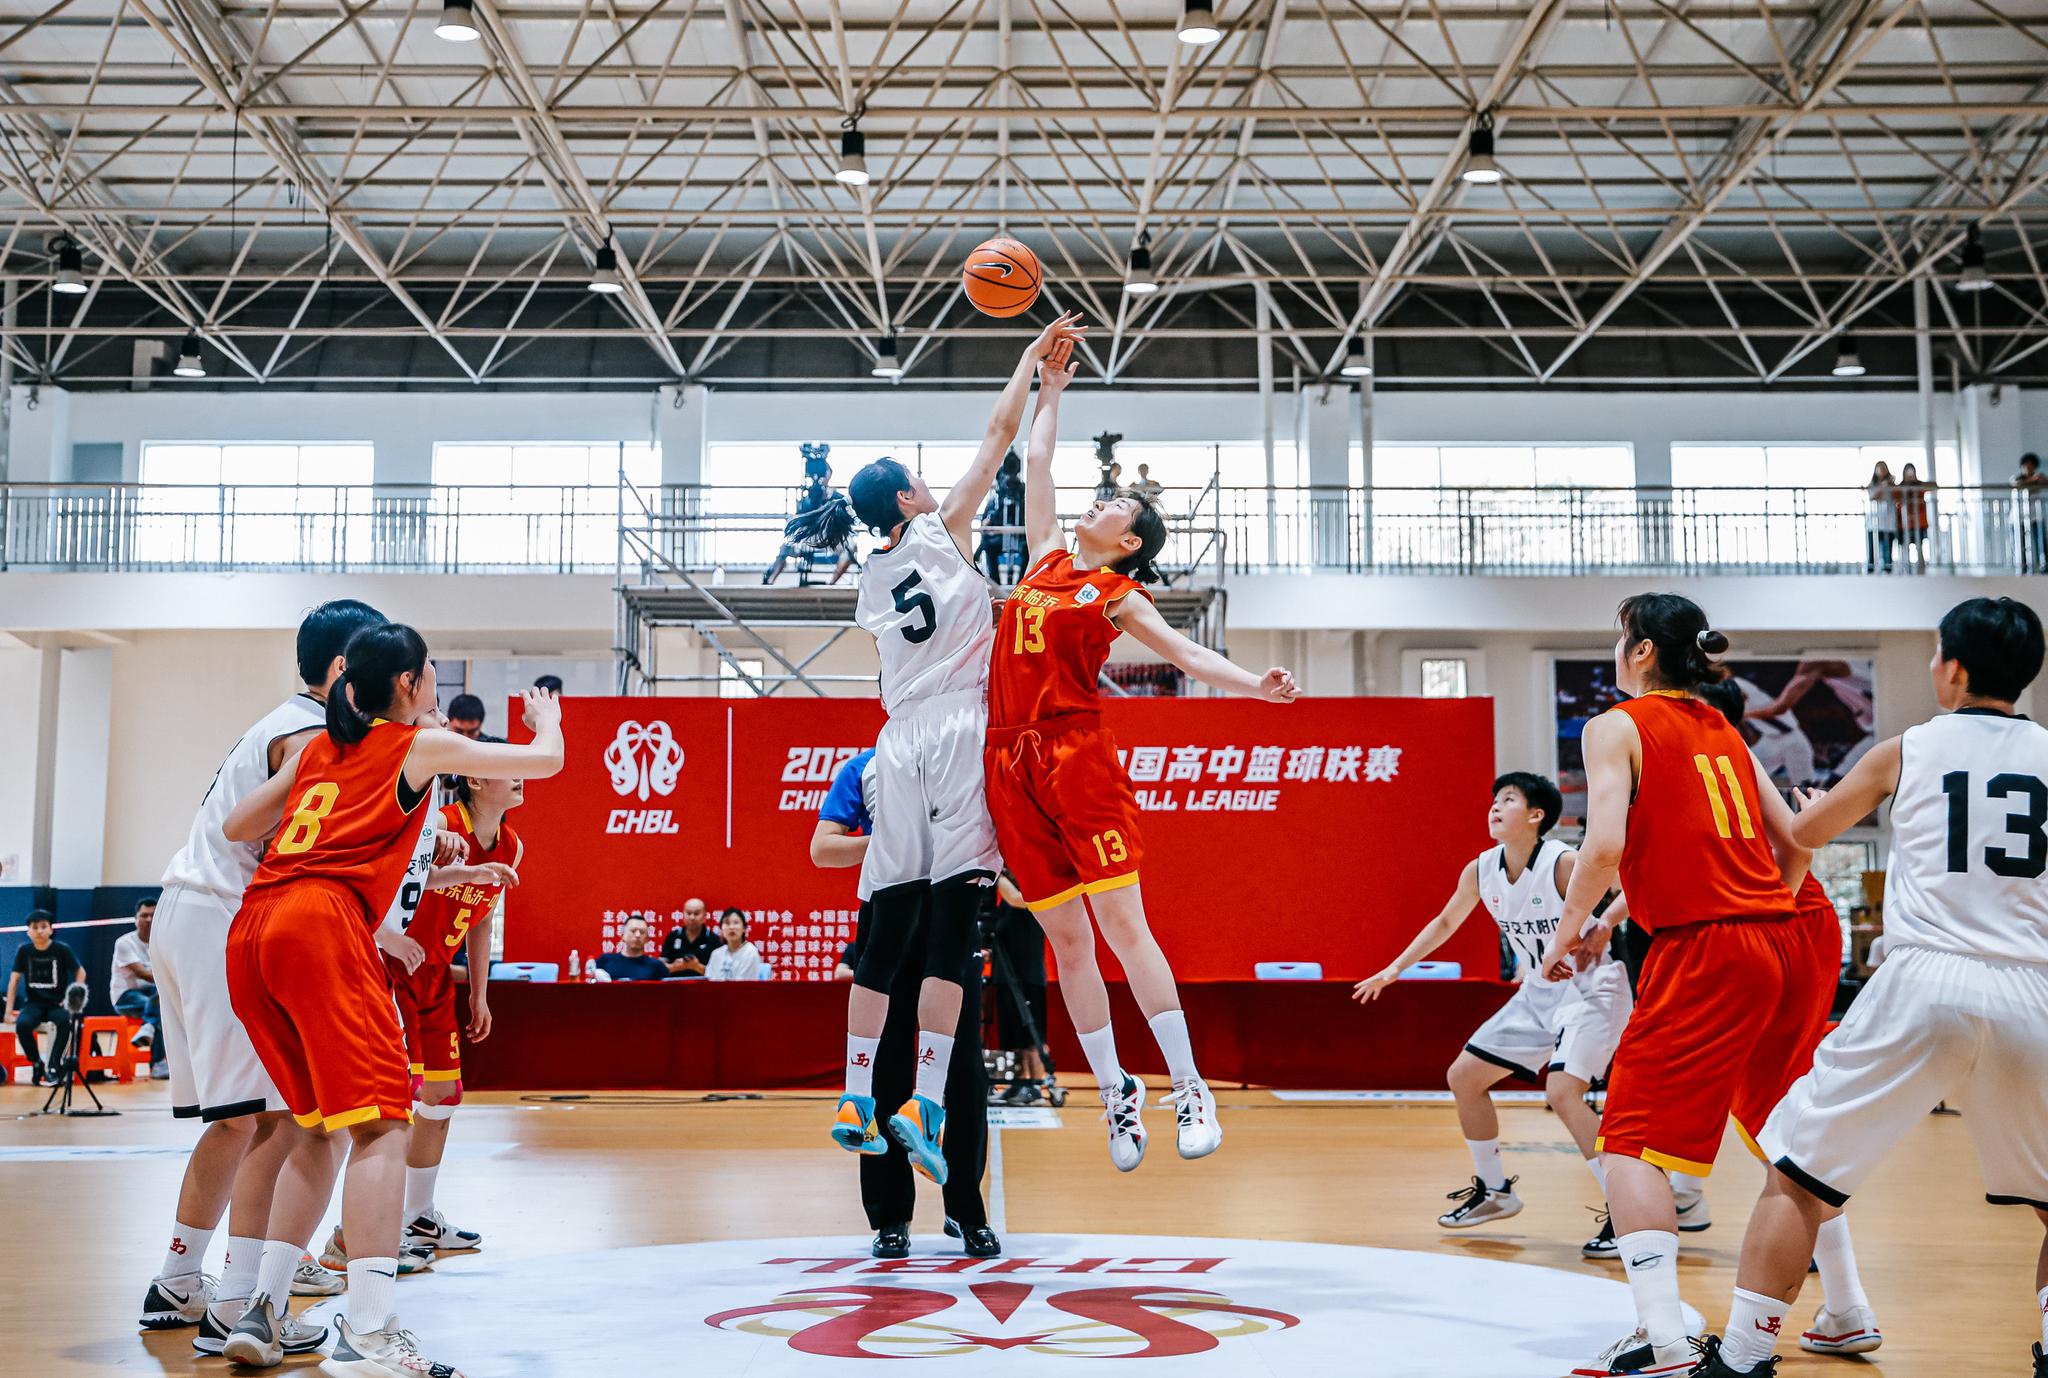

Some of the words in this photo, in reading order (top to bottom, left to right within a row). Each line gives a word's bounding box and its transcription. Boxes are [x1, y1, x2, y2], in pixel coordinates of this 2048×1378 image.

[891, 569, 937, 644] 5
[1014, 606, 1046, 654] 13
[781, 747, 874, 782] 202
[1185, 790, 1280, 811] LEAGUE
[1693, 754, 1755, 839] 11
[277, 782, 340, 854] 8
[605, 809, 680, 834] CHBL
[1942, 770, 2048, 879] 13
[1092, 829, 1127, 867] 13
[445, 908, 471, 946] 5
[450, 1032, 460, 1059] 5
[759, 1257, 1232, 1274] CHBL
